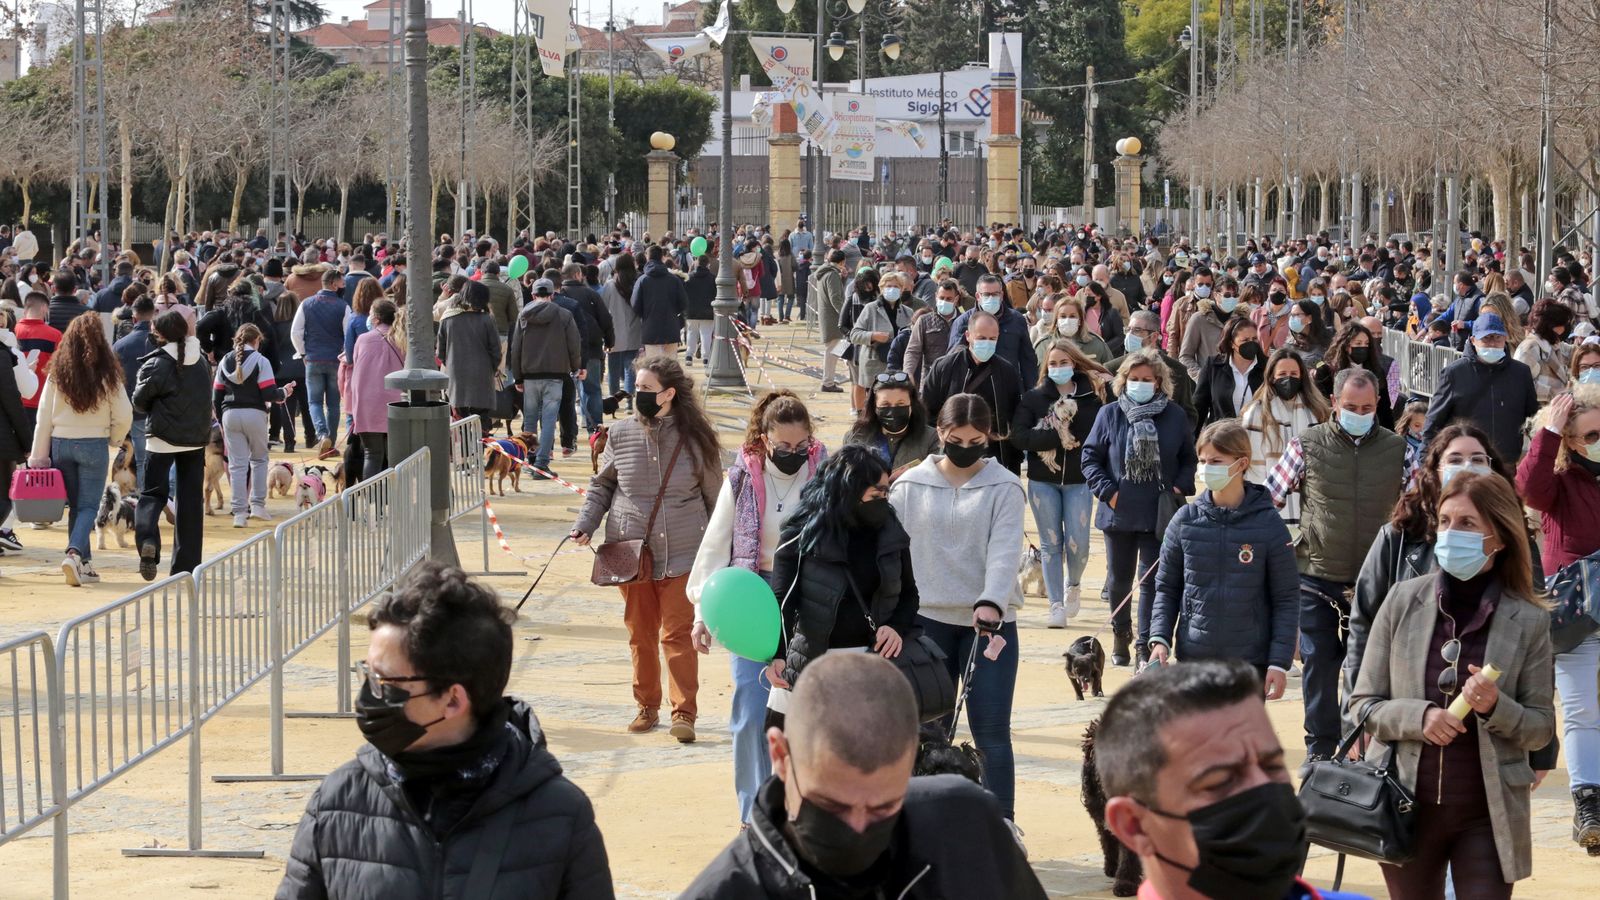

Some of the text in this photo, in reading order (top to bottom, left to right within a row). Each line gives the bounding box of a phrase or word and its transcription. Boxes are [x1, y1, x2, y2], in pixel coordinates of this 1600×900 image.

[869, 87, 958, 99] Instituto Médco
[907, 101, 958, 115] Siglo 21
